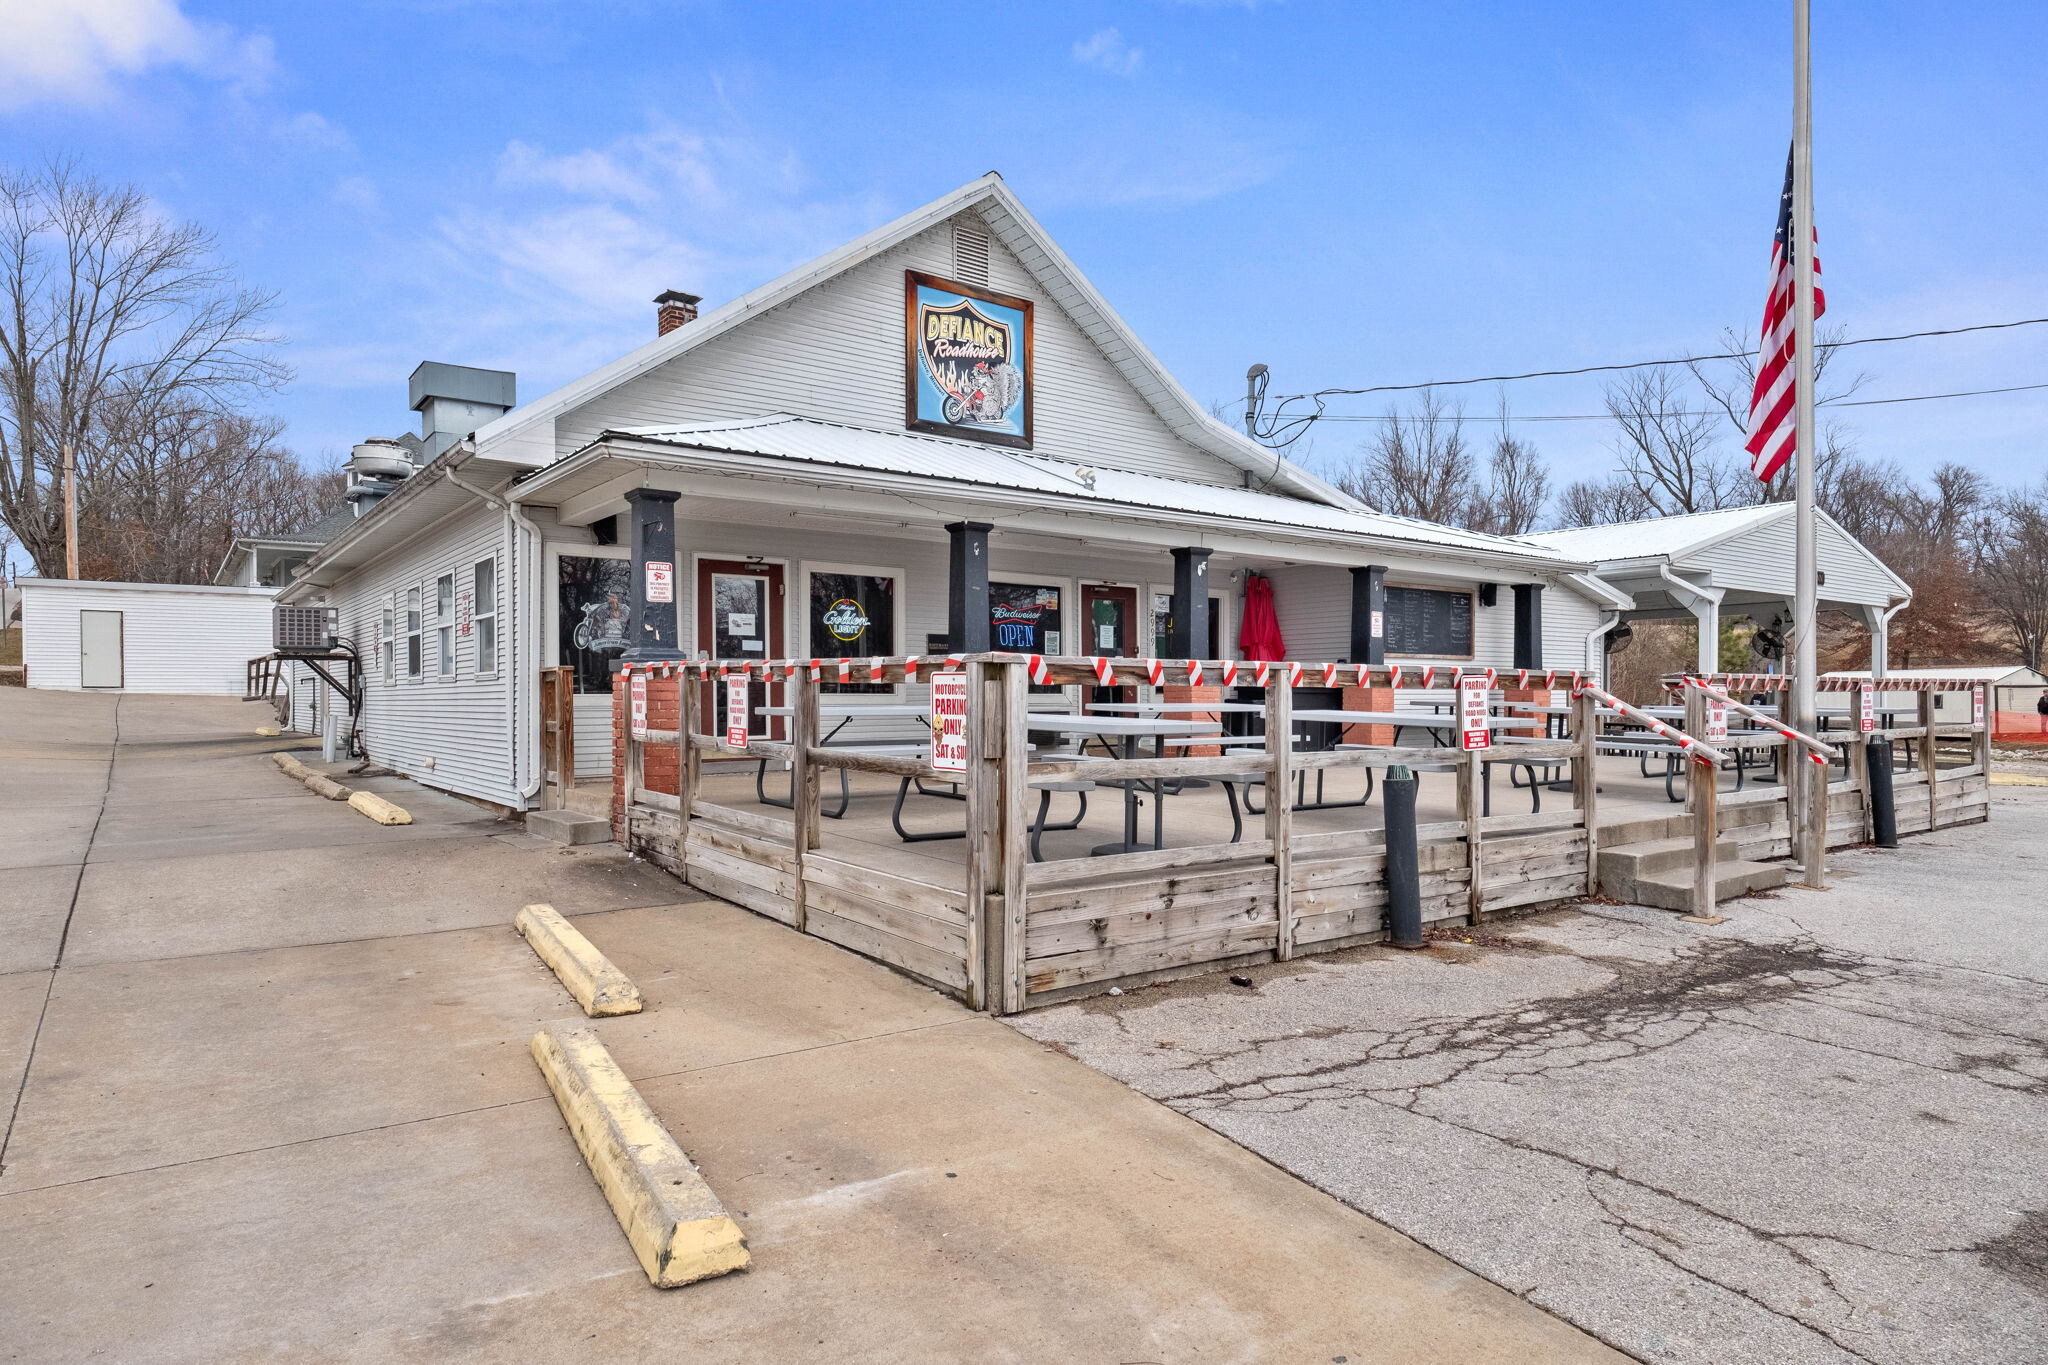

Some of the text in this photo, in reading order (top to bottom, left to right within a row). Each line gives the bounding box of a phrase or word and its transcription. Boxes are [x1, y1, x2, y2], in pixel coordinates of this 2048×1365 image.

[927, 314, 1004, 357] DEFIANCE
[934, 339, 999, 359] Roadhouse
[823, 610, 871, 626] Golden
[992, 606, 1041, 619] Budweiser
[833, 624, 859, 634] LIGHT
[999, 624, 1034, 647] OPEN
[729, 678, 746, 688] PARKING
[935, 683, 966, 696] MOTORCYCL
[1465, 680, 1487, 690] PARKING
[943, 718, 962, 735] ONLY
[1471, 718, 1483, 728] ONLY
[935, 744, 949, 758] SAT
[951, 746, 956, 759] &
